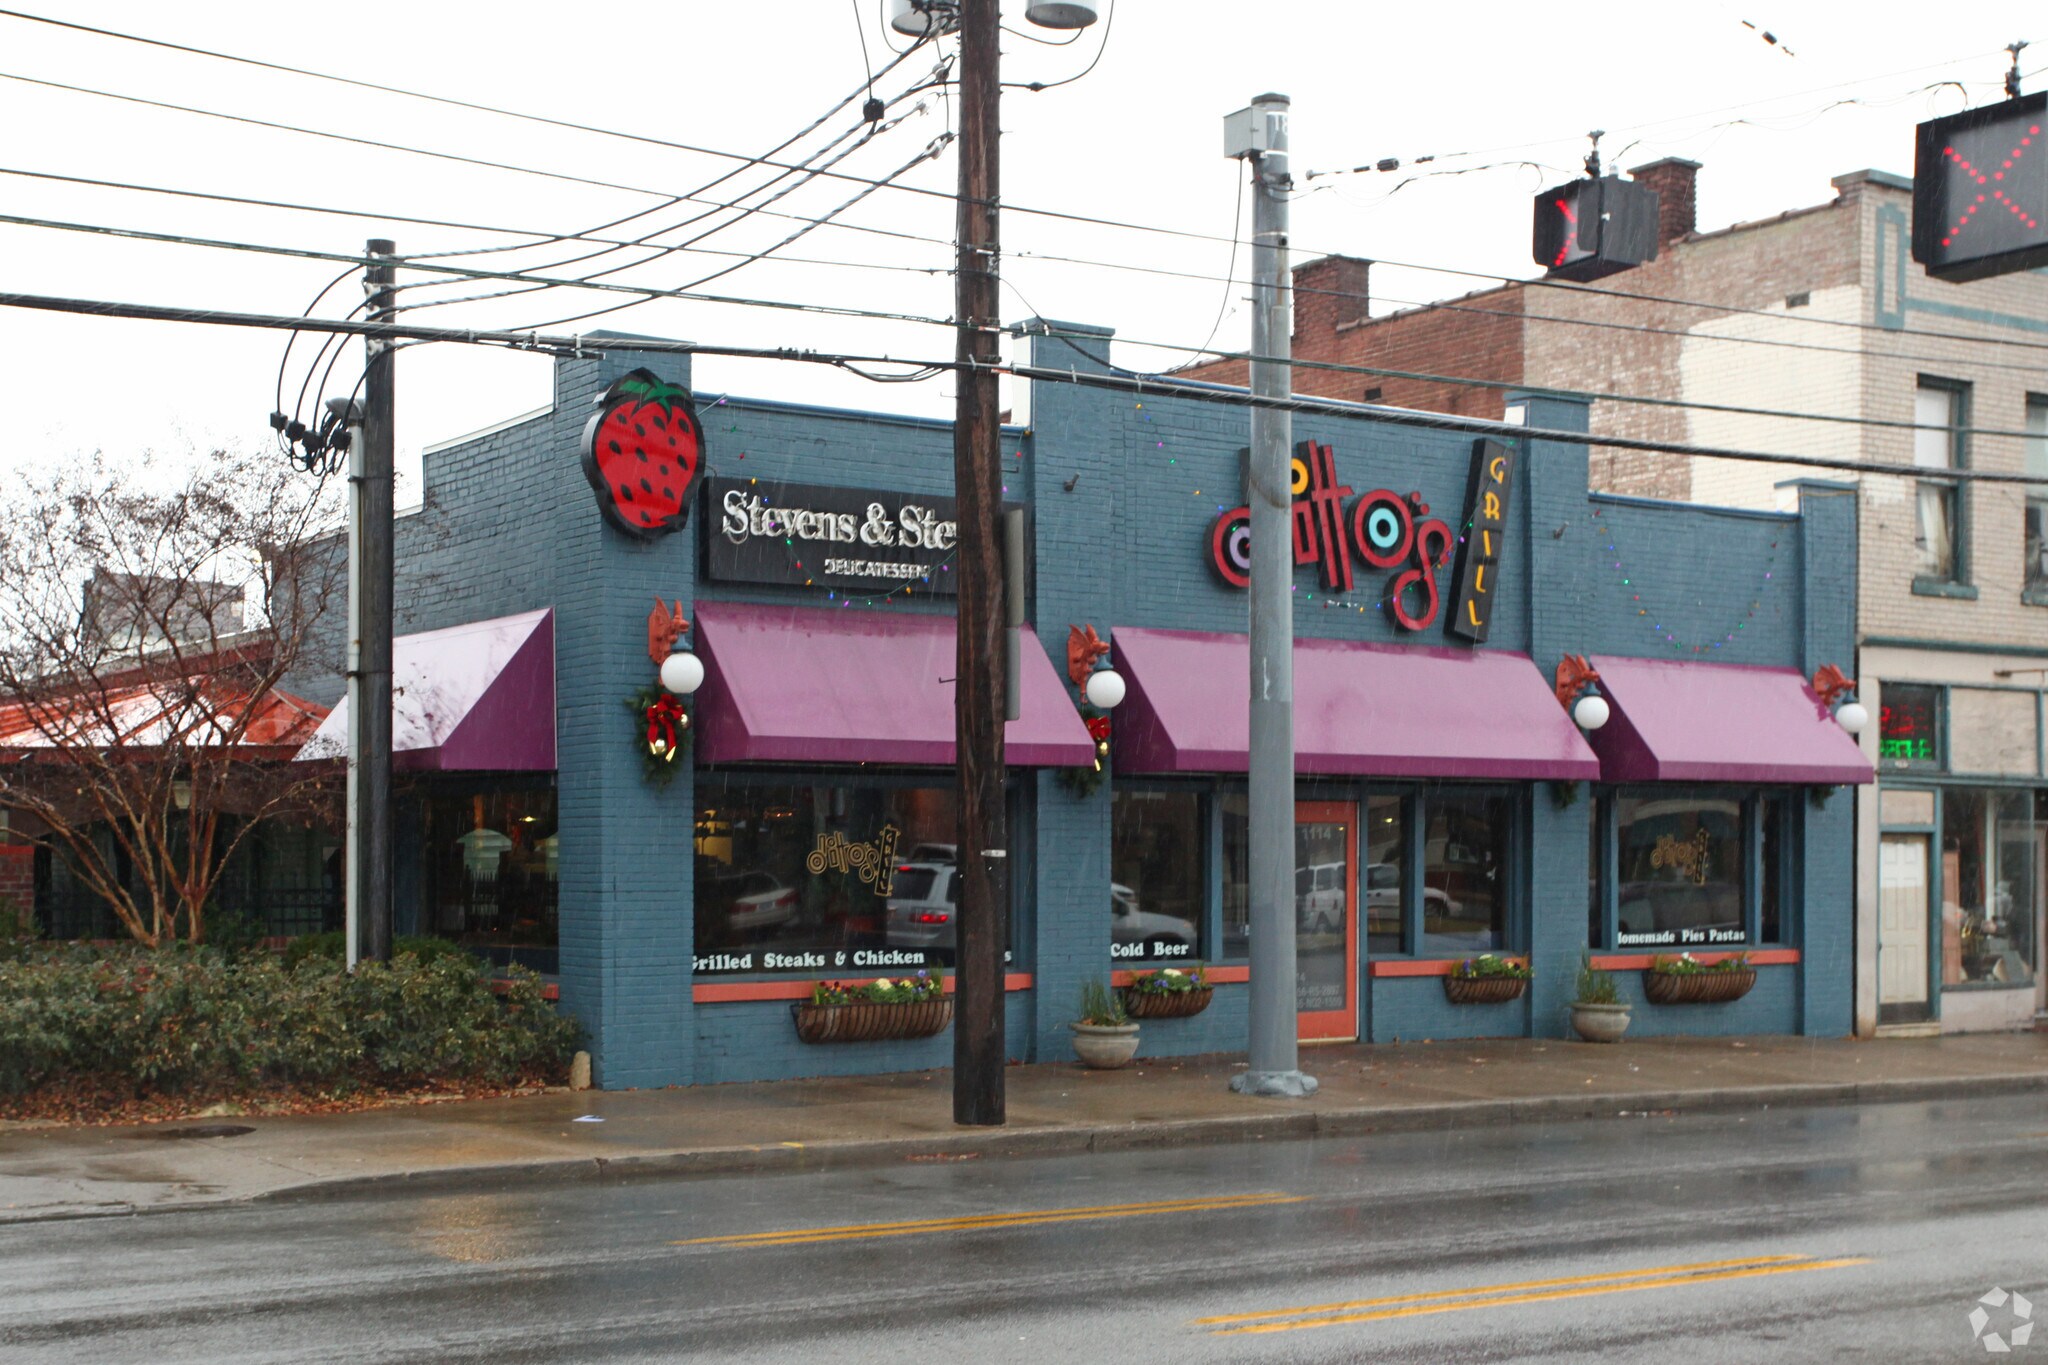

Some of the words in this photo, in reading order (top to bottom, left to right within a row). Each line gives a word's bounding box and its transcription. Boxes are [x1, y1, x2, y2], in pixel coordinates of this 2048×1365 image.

[722, 490, 857, 543] Stevens
[859, 502, 896, 546] &
[899, 504, 957, 550] Ste
[1464, 456, 1506, 627] GRILL
[824, 558, 930, 578] DELICATESSEN
[1301, 826, 1331, 840] 1114
[879, 832, 894, 891] GRILL
[1682, 929, 1705, 942] Pies
[1709, 929, 1745, 941] Pastas
[763, 952, 825, 968] Steaks
[834, 951, 846, 966] &
[853, 950, 925, 966] Chicken
[1111, 943, 1144, 957] Cold
[1153, 942, 1189, 956] Beer
